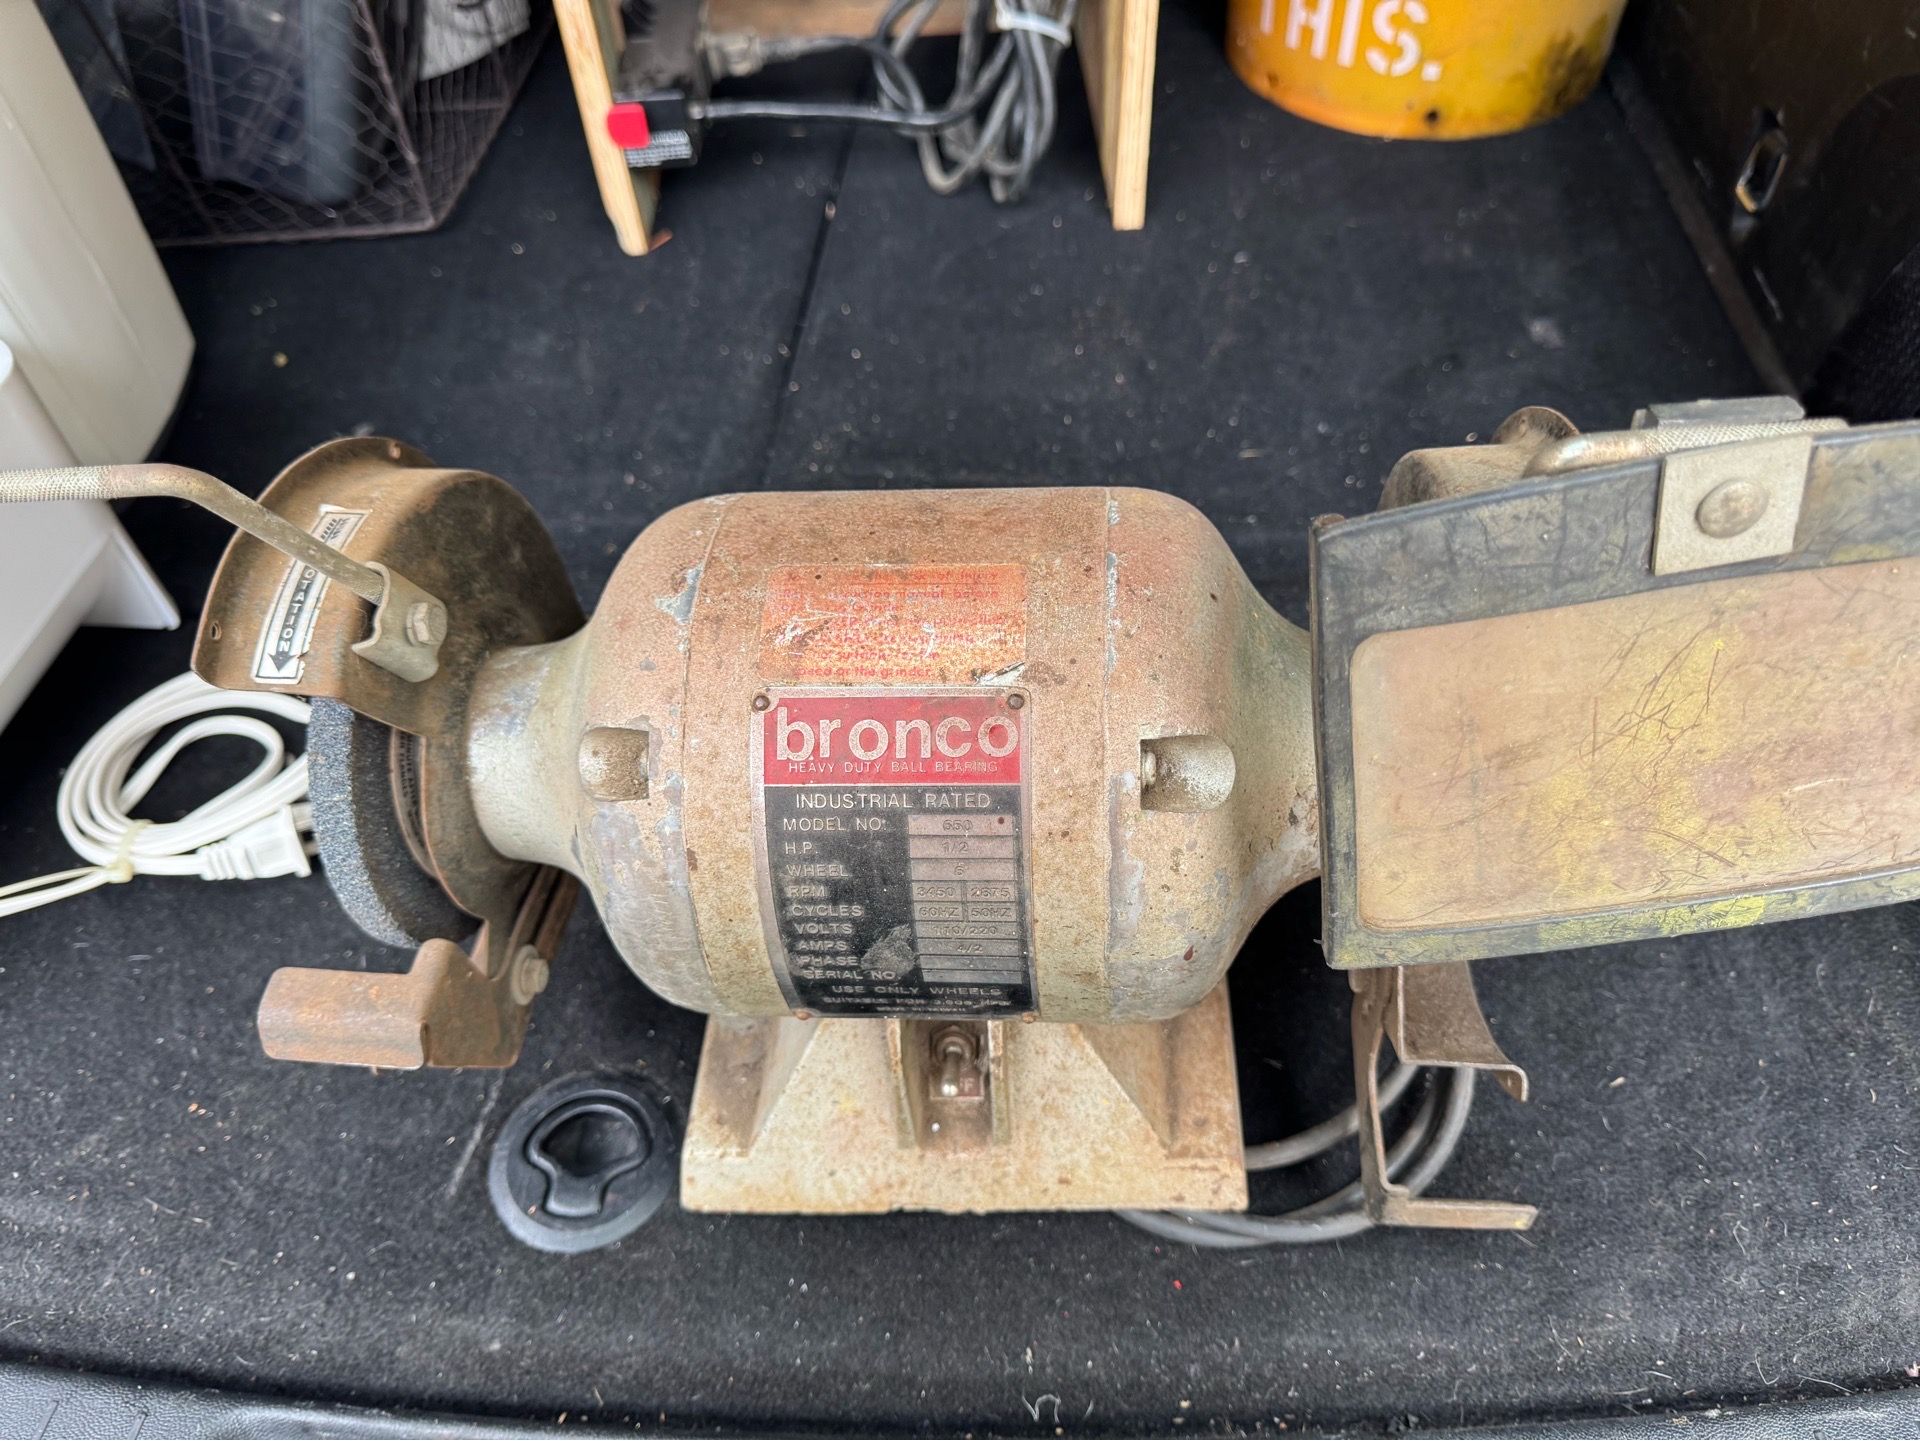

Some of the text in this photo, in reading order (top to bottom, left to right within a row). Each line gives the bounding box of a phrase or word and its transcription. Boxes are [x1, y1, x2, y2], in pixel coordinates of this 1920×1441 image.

[278, 568, 316, 652] OTATION
[776, 706, 1019, 761] bronco
[788, 761, 998, 773] HEAVY DUTY BALL BEARING
[796, 792, 991, 809] INDUSTRIAL RATED
[783, 817, 847, 832] MODEL
[786, 864, 849, 878] WHEEL
[789, 885, 827, 898] RPM
[791, 904, 863, 917] CYCLES
[794, 922, 853, 935] VOLTS
[799, 940, 848, 952] AMPS
[799, 955, 859, 967] PHASE
[803, 969, 864, 980] SERIAL
[831, 985, 1002, 997] USE ONLY WHEELS
